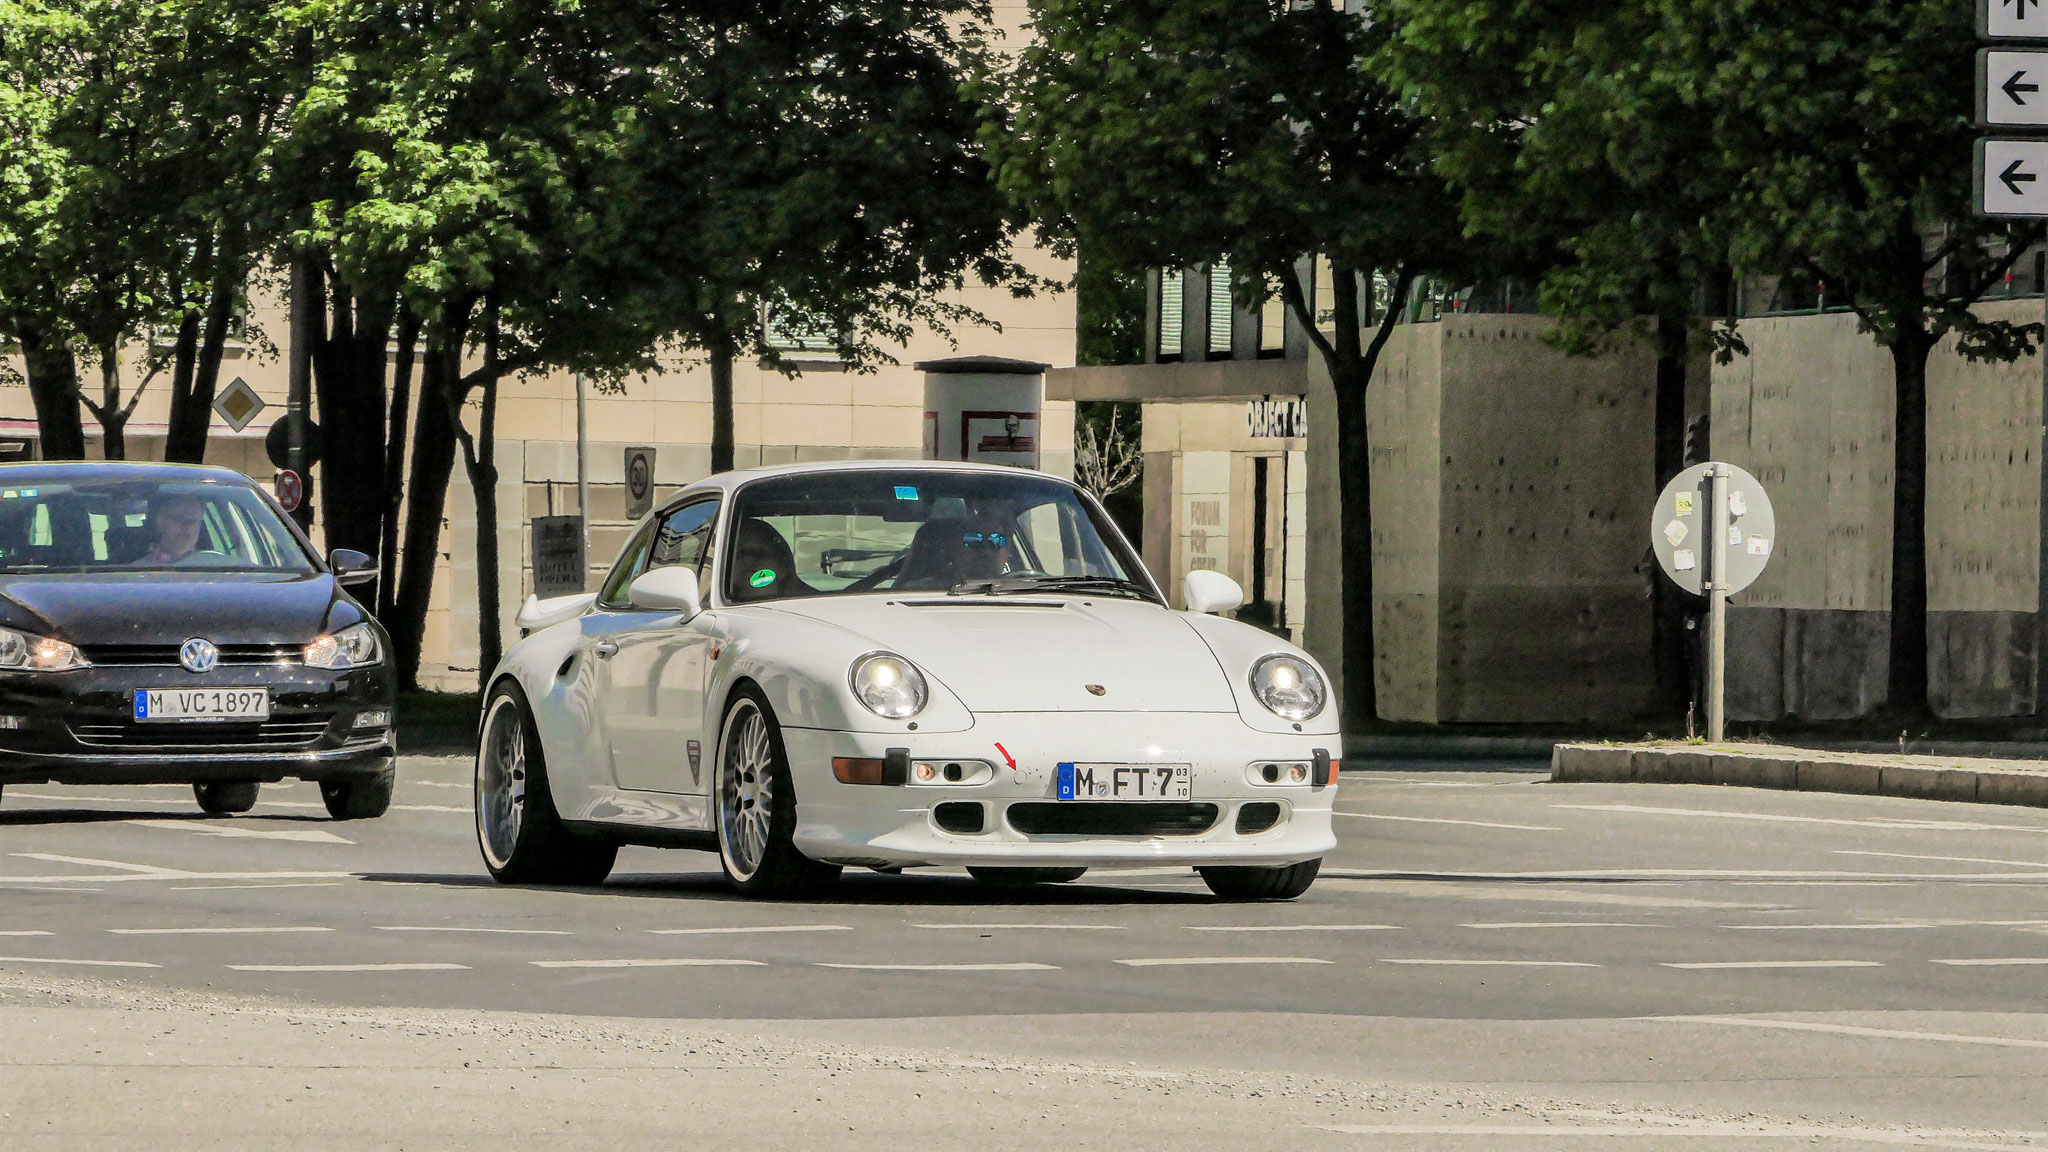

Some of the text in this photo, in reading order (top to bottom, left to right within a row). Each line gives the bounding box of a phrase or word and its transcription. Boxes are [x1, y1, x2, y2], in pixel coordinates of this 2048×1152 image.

[1247, 400, 1288, 437] OBJECT
[633, 466, 645, 487] 30
[1190, 501, 1220, 526] FORUM
[150, 692, 264, 713] M VC 1897
[1075, 768, 1174, 796] M FT 7
[1176, 768, 1188, 777] 03
[1062, 785, 1070, 795] D
[1177, 788, 1188, 796] 10
